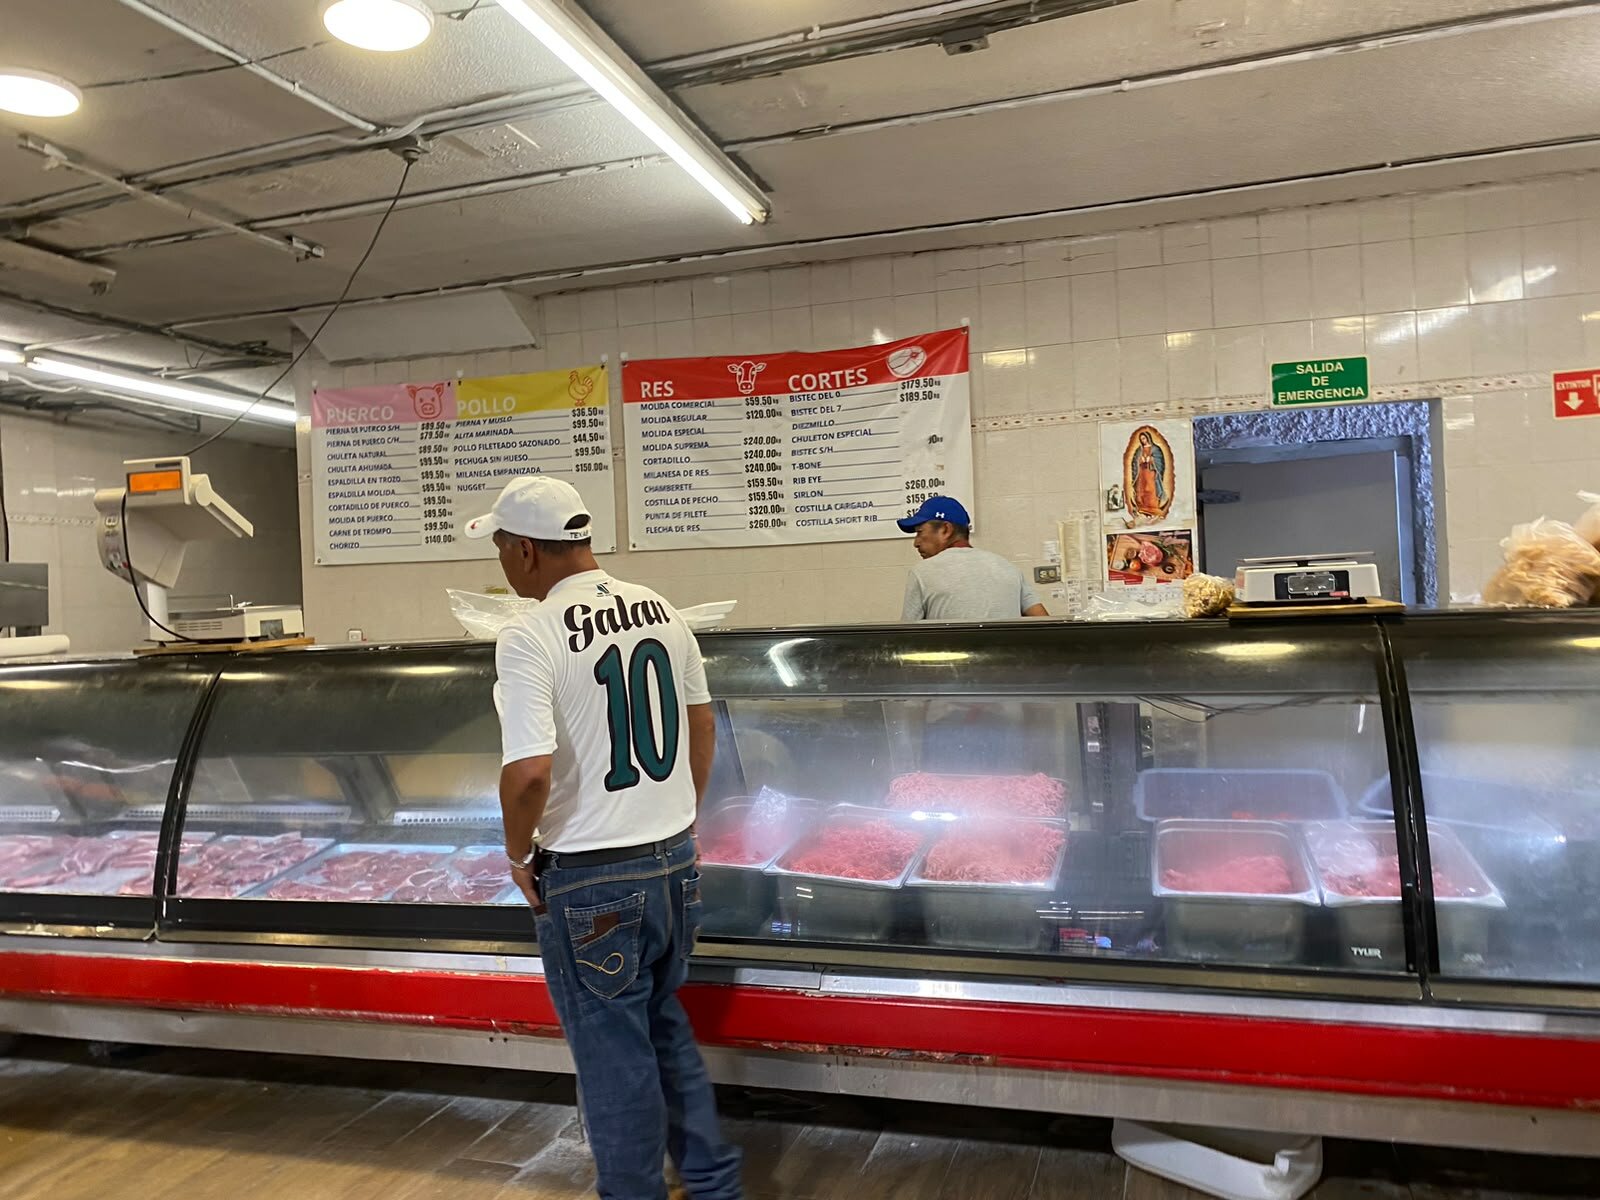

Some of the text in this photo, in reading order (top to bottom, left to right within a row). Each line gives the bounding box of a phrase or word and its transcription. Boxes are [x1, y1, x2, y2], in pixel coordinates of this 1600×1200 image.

[1296, 362, 1344, 374] SALIDA
[788, 368, 868, 392] CORTES
[1312, 376, 1329, 386] DE
[641, 381, 674, 398] RES
[1278, 387, 1364, 402] EMERGENCIA
[790, 394, 816, 402] BISTEC
[457, 397, 515, 415] POLLO
[791, 408, 817, 416] BISTEC
[820, 406, 834, 414] DEL
[326, 406, 393, 424] PUERCO
[641, 416, 671, 424] MOLIDA
[673, 414, 706, 422] REGULAR
[456, 419, 481, 427] PIERNA
[488, 416, 512, 424] MUSLO
[454, 431, 474, 439] ALITA
[475, 428, 513, 438] MARINADA
[642, 428, 705, 438] MOLIDA ESPECIAL
[792, 431, 834, 443] CHULETON
[837, 429, 873, 438] ESPECIAL
[454, 444, 477, 452] POLLO
[479, 441, 517, 450] FILETEADO
[518, 438, 560, 448] SAZONADO
[327, 452, 357, 461] CHULETA
[792, 448, 817, 457] BISTEC
[455, 456, 488, 465] PECHUGA
[490, 455, 501, 463] SIN
[503, 454, 528, 462] HUESO
[643, 456, 690, 465] CORTADILLO
[792, 462, 821, 470] T-BONE
[456, 469, 491, 479] MILANESA
[494, 467, 541, 476] EMPANIZADA
[644, 470, 680, 479] MILANESA
[457, 484, 486, 492] NUGGET
[794, 490, 823, 499] SIRLON
[645, 498, 679, 506] COSTILLA
[795, 503, 832, 513] COSTILLA
[835, 501, 874, 510] CARGADA
[329, 516, 355, 524] MOLIDA
[645, 512, 670, 520] PUNTA
[796, 517, 833, 526] COSTILLA
[836, 516, 862, 524] SHORT
[646, 526, 673, 534] FLECHA
[564, 595, 670, 652] Galan
[594, 638, 679, 792] 10
[1351, 947, 1382, 959] TYLER
